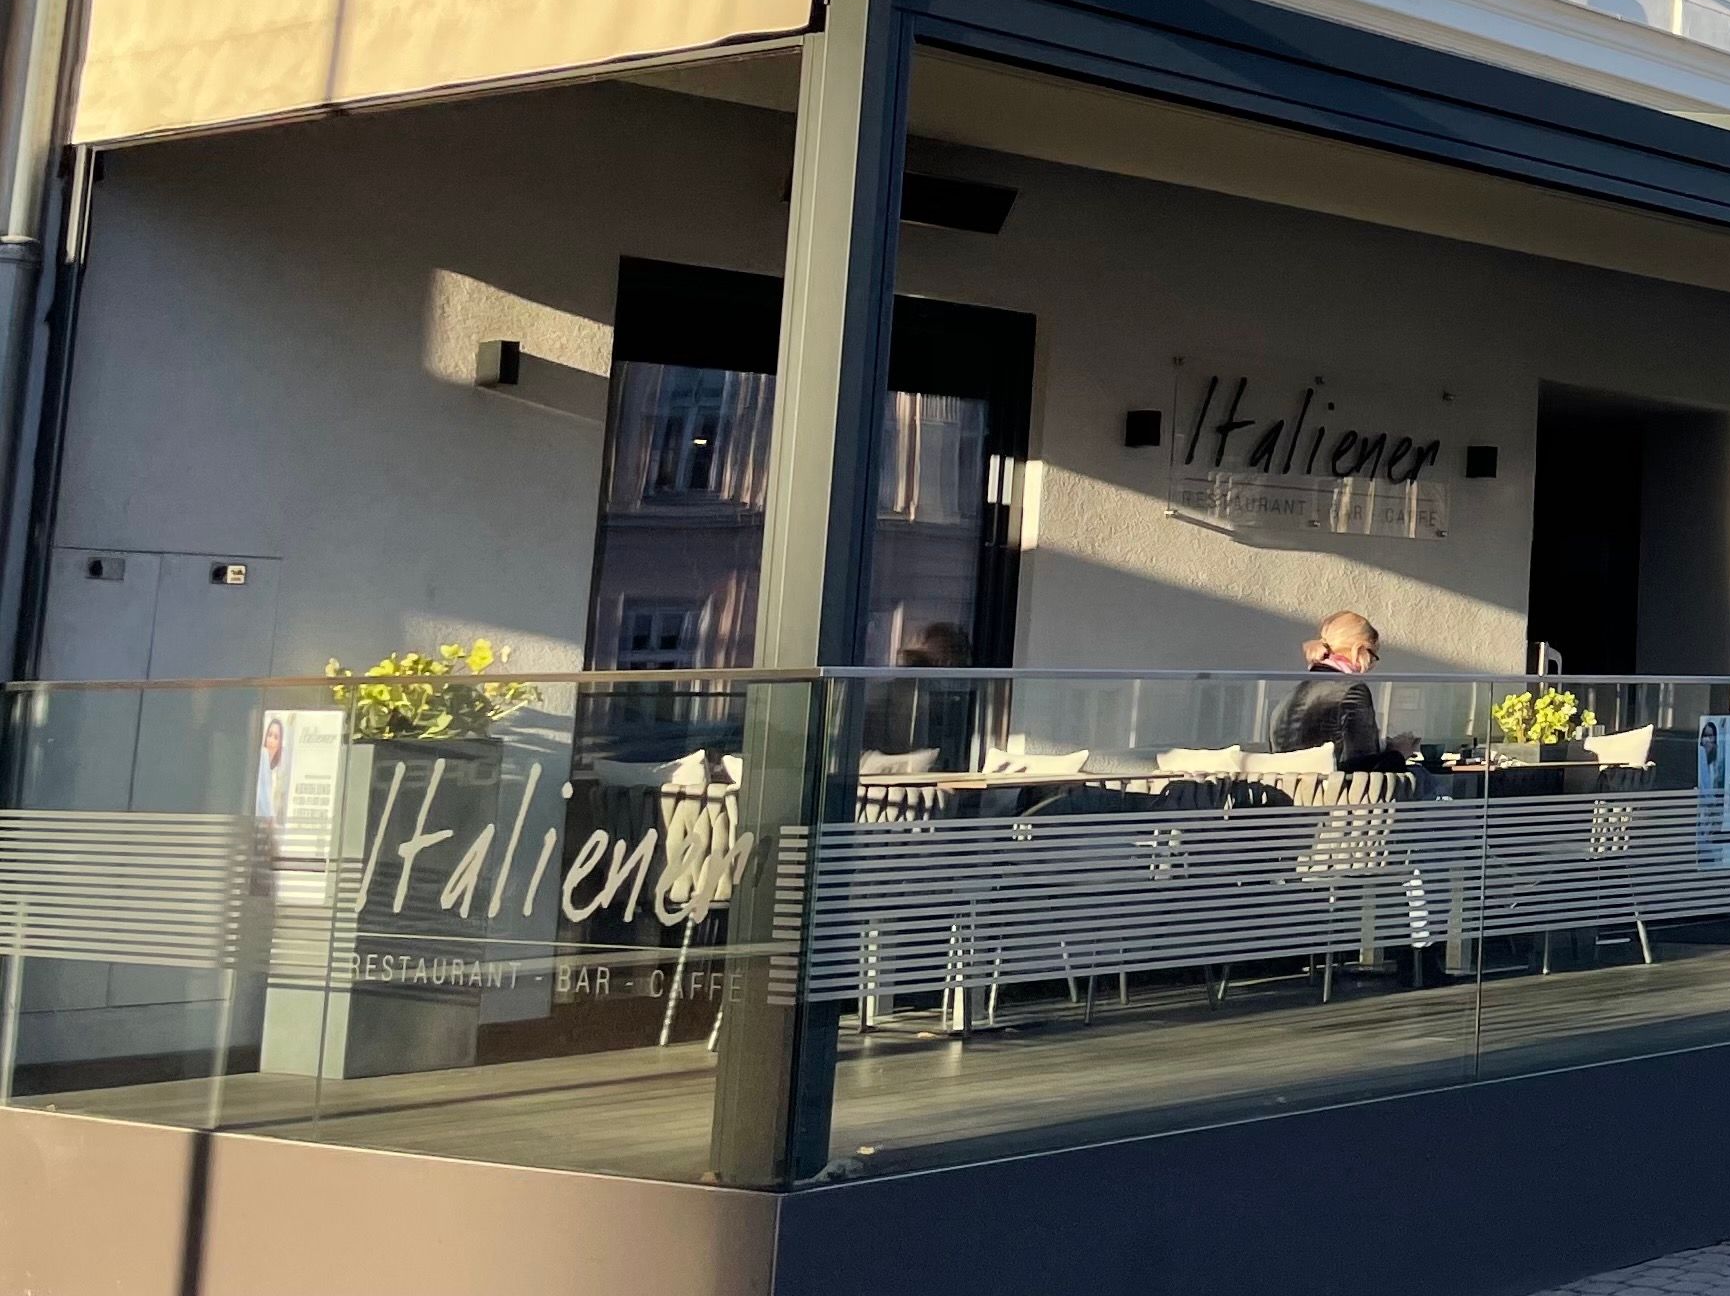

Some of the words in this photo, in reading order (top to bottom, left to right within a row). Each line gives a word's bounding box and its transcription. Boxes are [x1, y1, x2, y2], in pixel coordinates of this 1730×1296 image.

[1185, 376, 1440, 485] Italiener
[355, 758, 755, 924] Italiener
[350, 952, 522, 989] RESTAURANT
[558, 964, 612, 995] BAR
